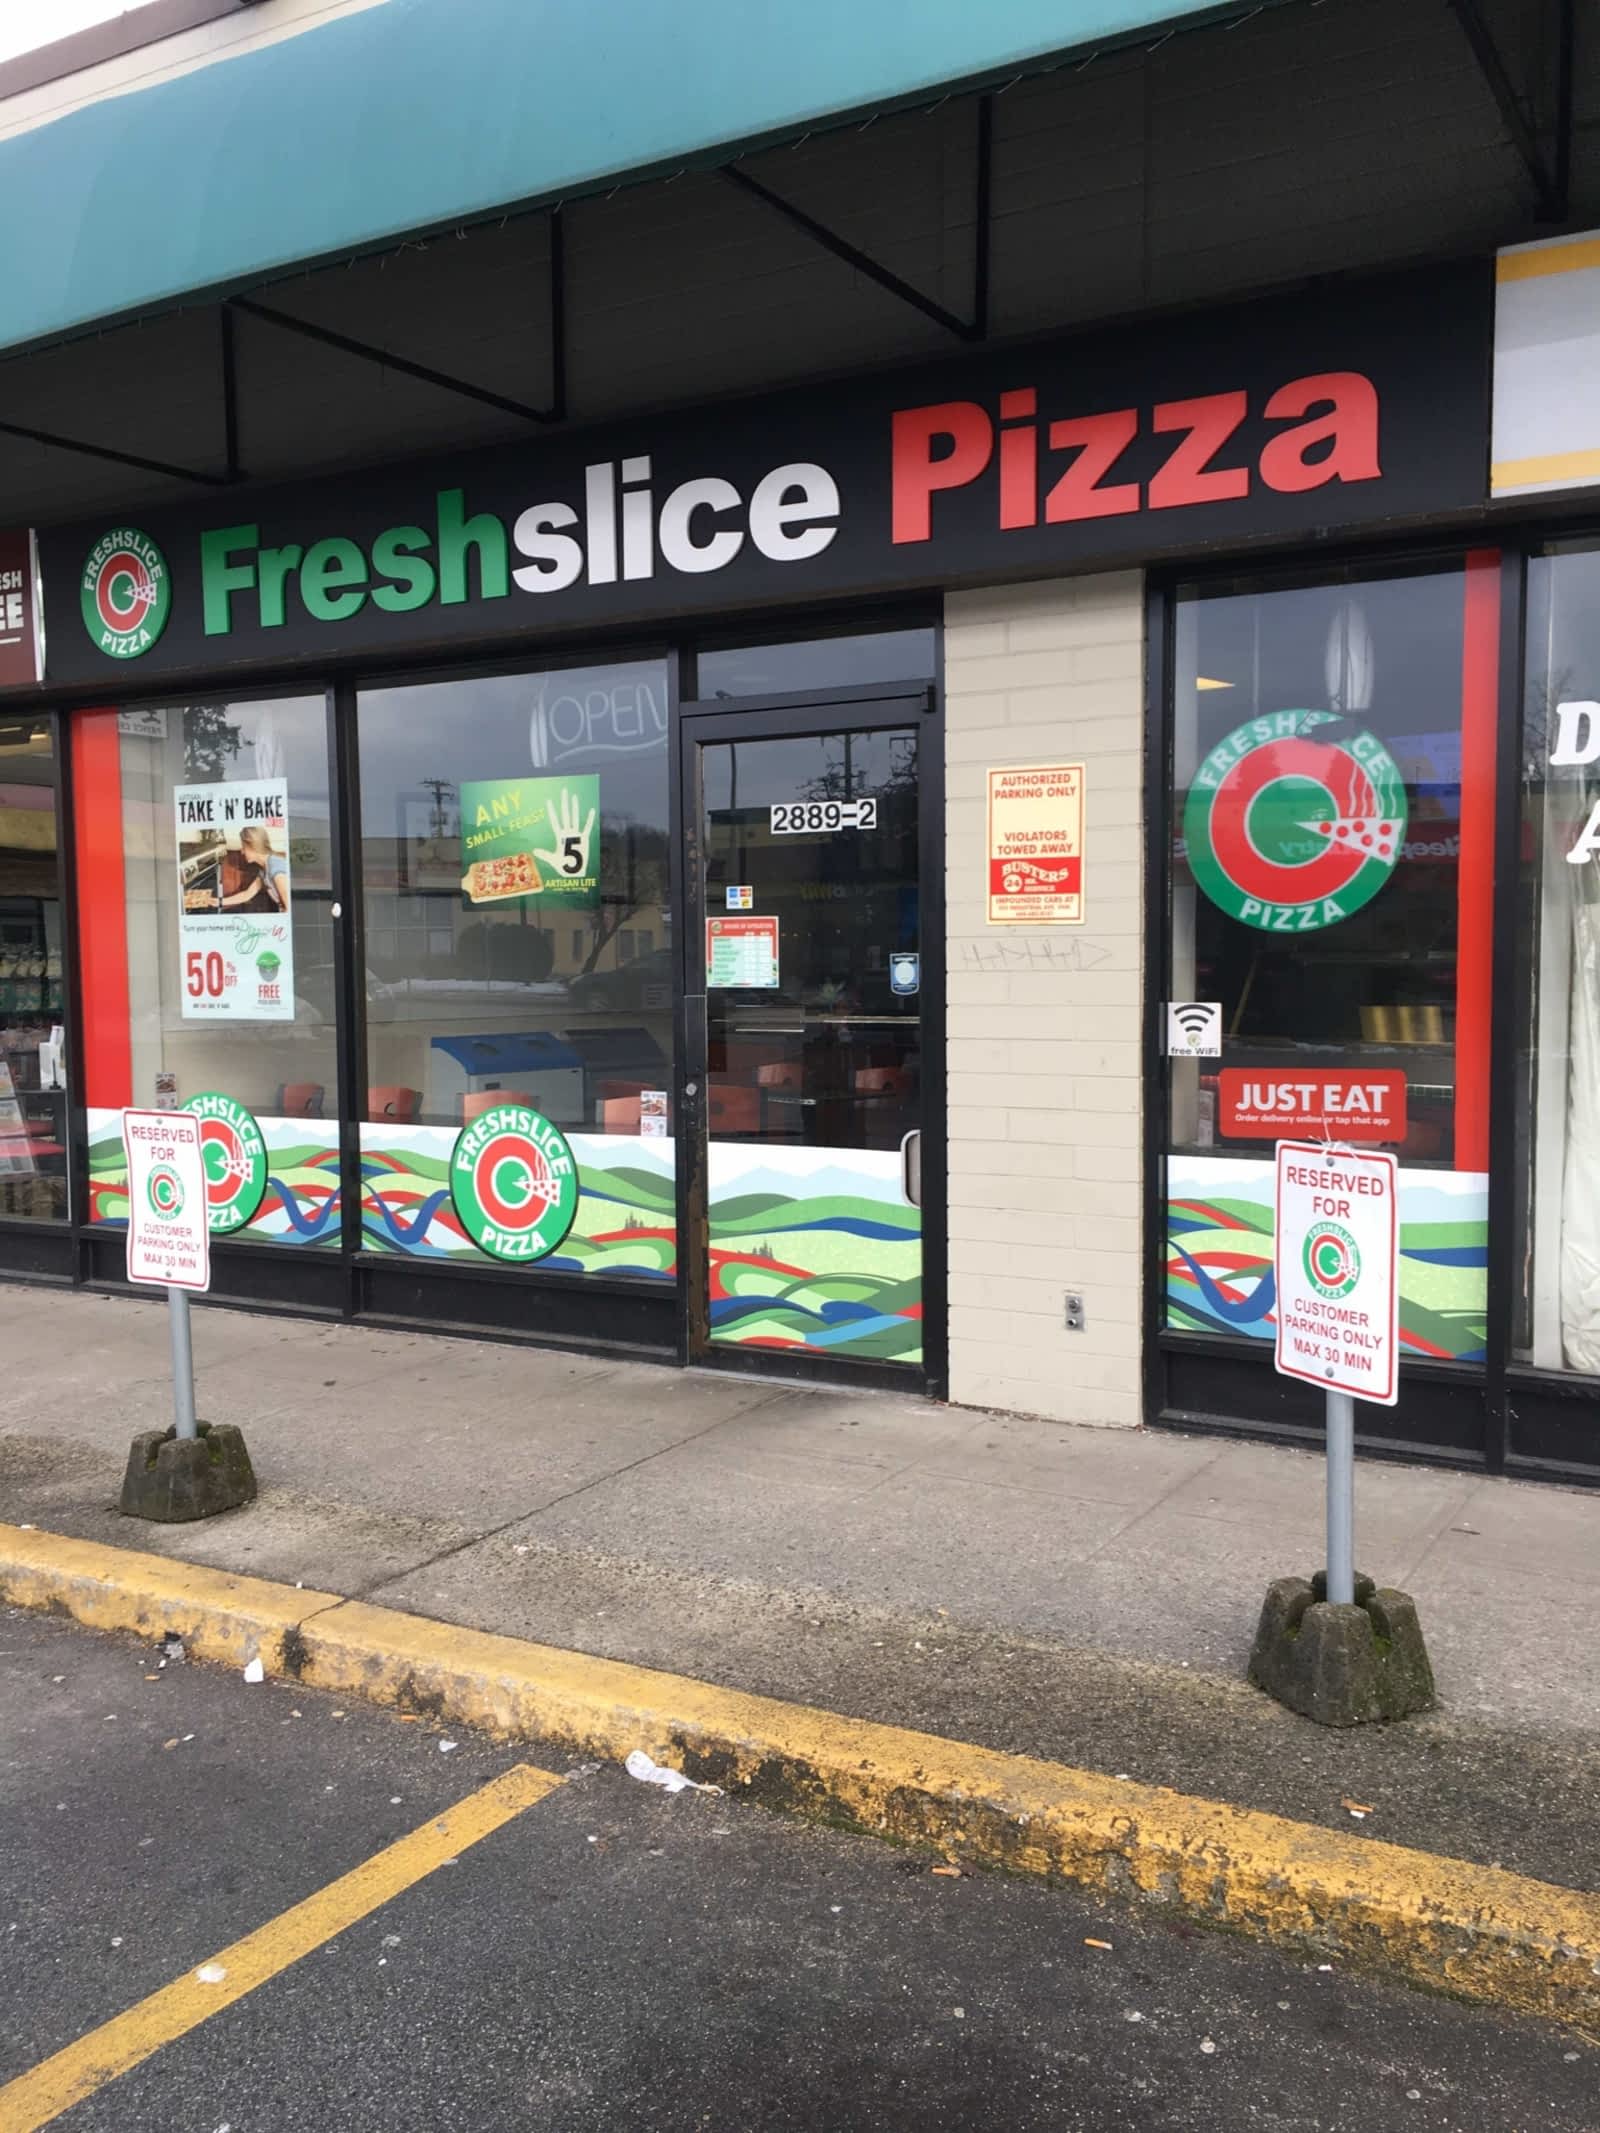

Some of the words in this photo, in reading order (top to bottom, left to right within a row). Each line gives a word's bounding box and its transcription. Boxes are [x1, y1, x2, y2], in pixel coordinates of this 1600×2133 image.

[202, 454, 841, 637] Freshslice
[891, 371, 1383, 545] Pizza
[84, 530, 163, 591] FRESHSLICE
[101, 628, 151, 655] PIZZA
[549, 682, 668, 745] OPEN
[994, 787, 1043, 800] PARKING
[1047, 785, 1076, 798] ONLY
[1000, 773, 1071, 787] AUTHORIZED
[178, 799, 214, 823] TAKE
[244, 795, 283, 819] BAKE
[476, 788, 522, 828] ANY
[772, 800, 875, 832] 2889-2
[465, 825, 505, 849] SMALL
[997, 844, 1037, 856] TOWED
[1040, 843, 1074, 854] AWAY
[1004, 830, 1067, 843] VIOLATORS
[1002, 861, 1070, 883] BUSTERS
[1239, 898, 1346, 930] PIZZA
[187, 950, 224, 998] 50
[258, 984, 281, 999] FREE
[1170, 1046, 1192, 1056] free
[1235, 1083, 1317, 1111] JUST
[1323, 1084, 1390, 1113] EAT
[1235, 1113, 1259, 1122] Order
[1261, 1114, 1294, 1125] delivery
[1335, 1116, 1350, 1126] tap
[1352, 1116, 1371, 1125] that
[1373, 1117, 1391, 1127] app
[130, 1125, 195, 1144] RESERVED
[456, 1108, 572, 1177] FRESHSLICE
[150, 1146, 176, 1161] FOR
[1286, 1165, 1385, 1197] RESERVED
[1312, 1196, 1351, 1219] FOR
[144, 1222, 193, 1238] CUSTOMER
[480, 1224, 548, 1256] PIZZA
[137, 1235, 175, 1251] PARKING
[176, 1241, 201, 1253] ONLY
[143, 1252, 163, 1264] MAX
[164, 1254, 176, 1266] 30
[178, 1256, 197, 1269] MIN
[1294, 1298, 1370, 1328] CUSTOMER
[1284, 1314, 1339, 1341] PARKING
[1342, 1330, 1383, 1351] ONLY
[1293, 1337, 1321, 1358] MAX
[1325, 1346, 1340, 1364] 30
[1344, 1350, 1373, 1372] MIN
